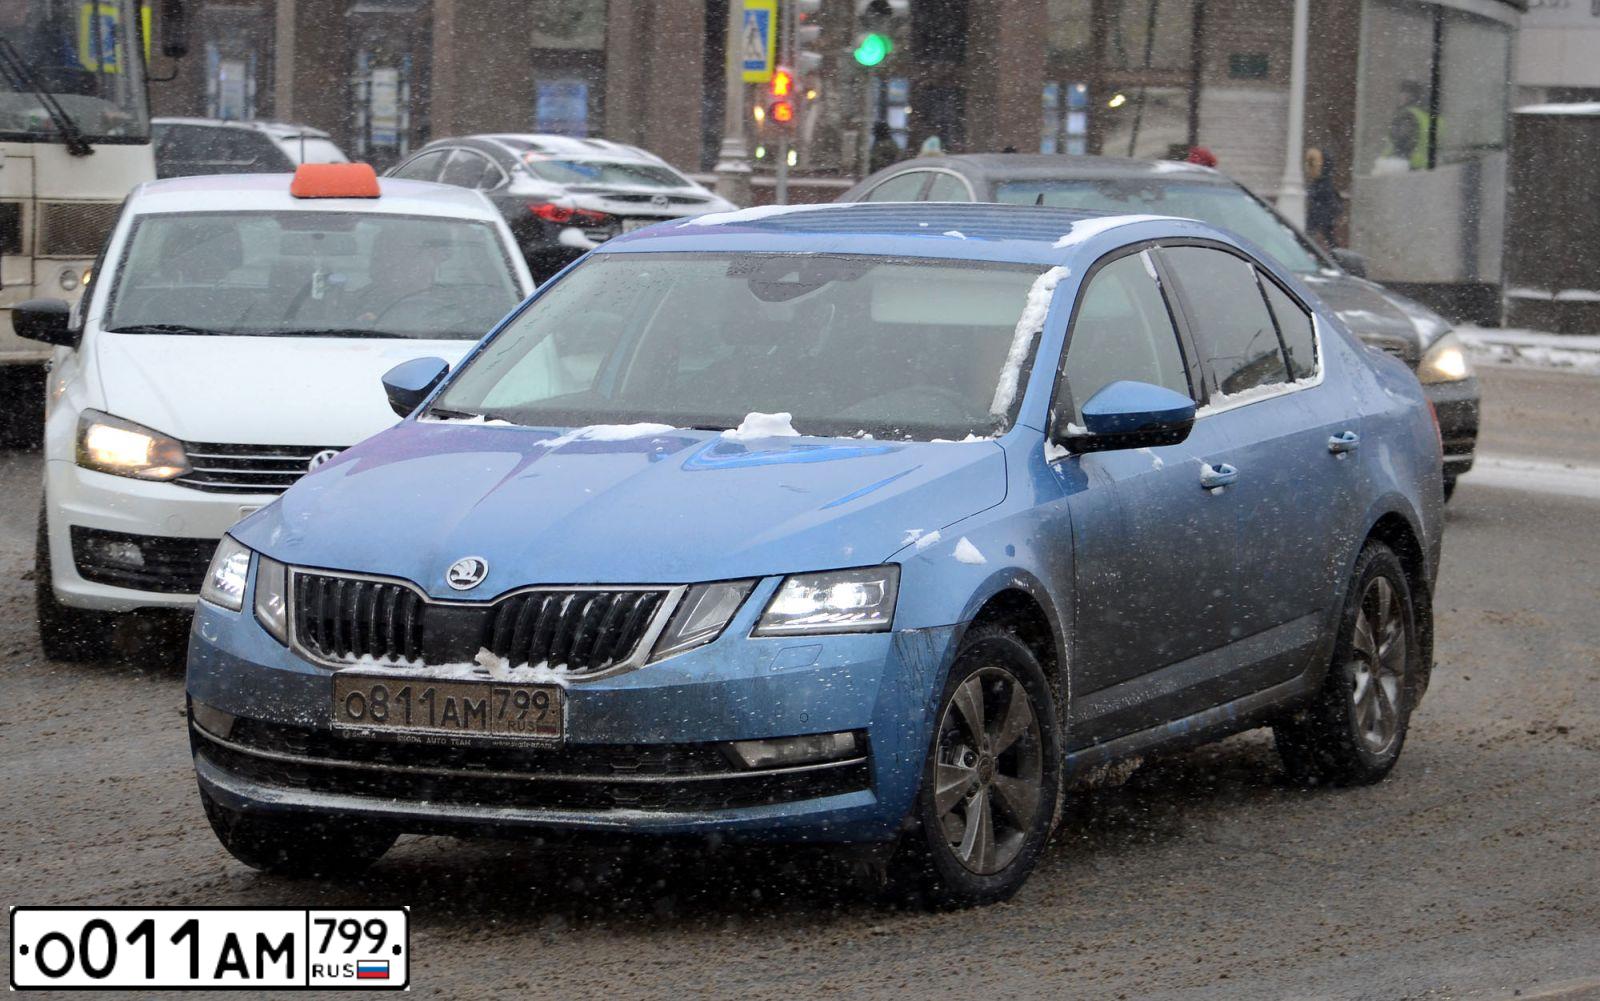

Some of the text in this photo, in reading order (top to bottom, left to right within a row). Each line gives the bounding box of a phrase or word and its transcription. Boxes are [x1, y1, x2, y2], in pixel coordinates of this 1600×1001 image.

[494, 688, 550, 721] 799
[507, 720, 536, 732] RUS
[426, 736, 448, 745] AUTO
[450, 738, 472, 747] TEAM
